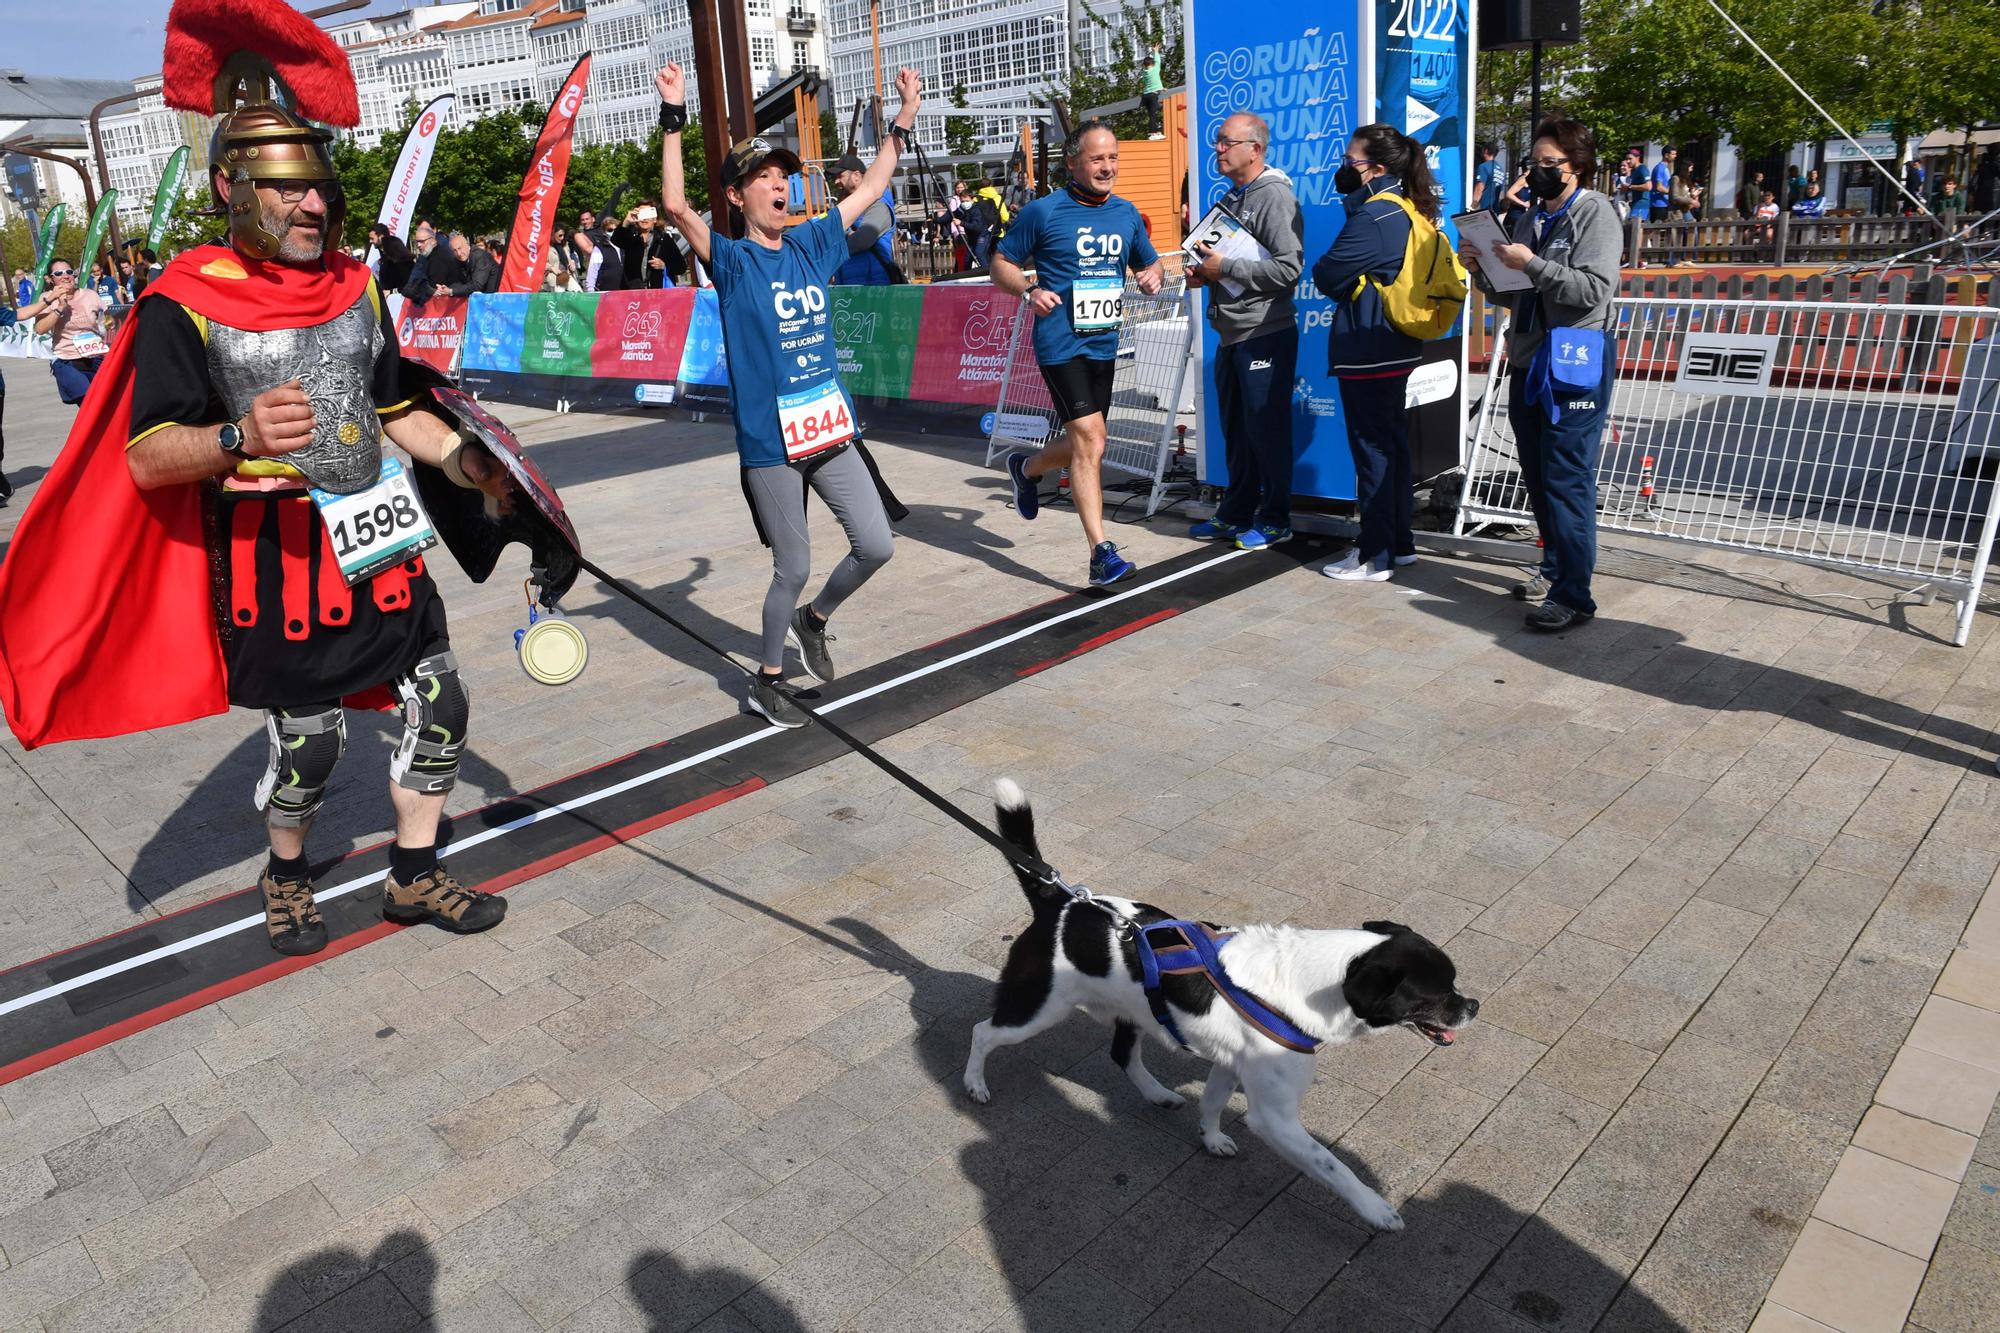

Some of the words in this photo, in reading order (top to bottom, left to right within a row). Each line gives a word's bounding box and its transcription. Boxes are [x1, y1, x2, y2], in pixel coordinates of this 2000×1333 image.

[1388, 0, 1457, 41] 2022
[1203, 27, 1348, 84] CORUÑA
[1205, 62, 1348, 117] CORUÑA
[1840, 142, 1894, 156] farmac
[397, 145, 422, 206] DEPORTE
[1076, 298, 1122, 319] 1709
[781, 341, 797, 350] POR
[797, 332, 825, 347] UCRAÍN
[958, 366, 1006, 381] Atlántic
[784, 404, 849, 448] 1844
[1569, 401, 1596, 410] RFEA
[333, 494, 419, 558] 1598
